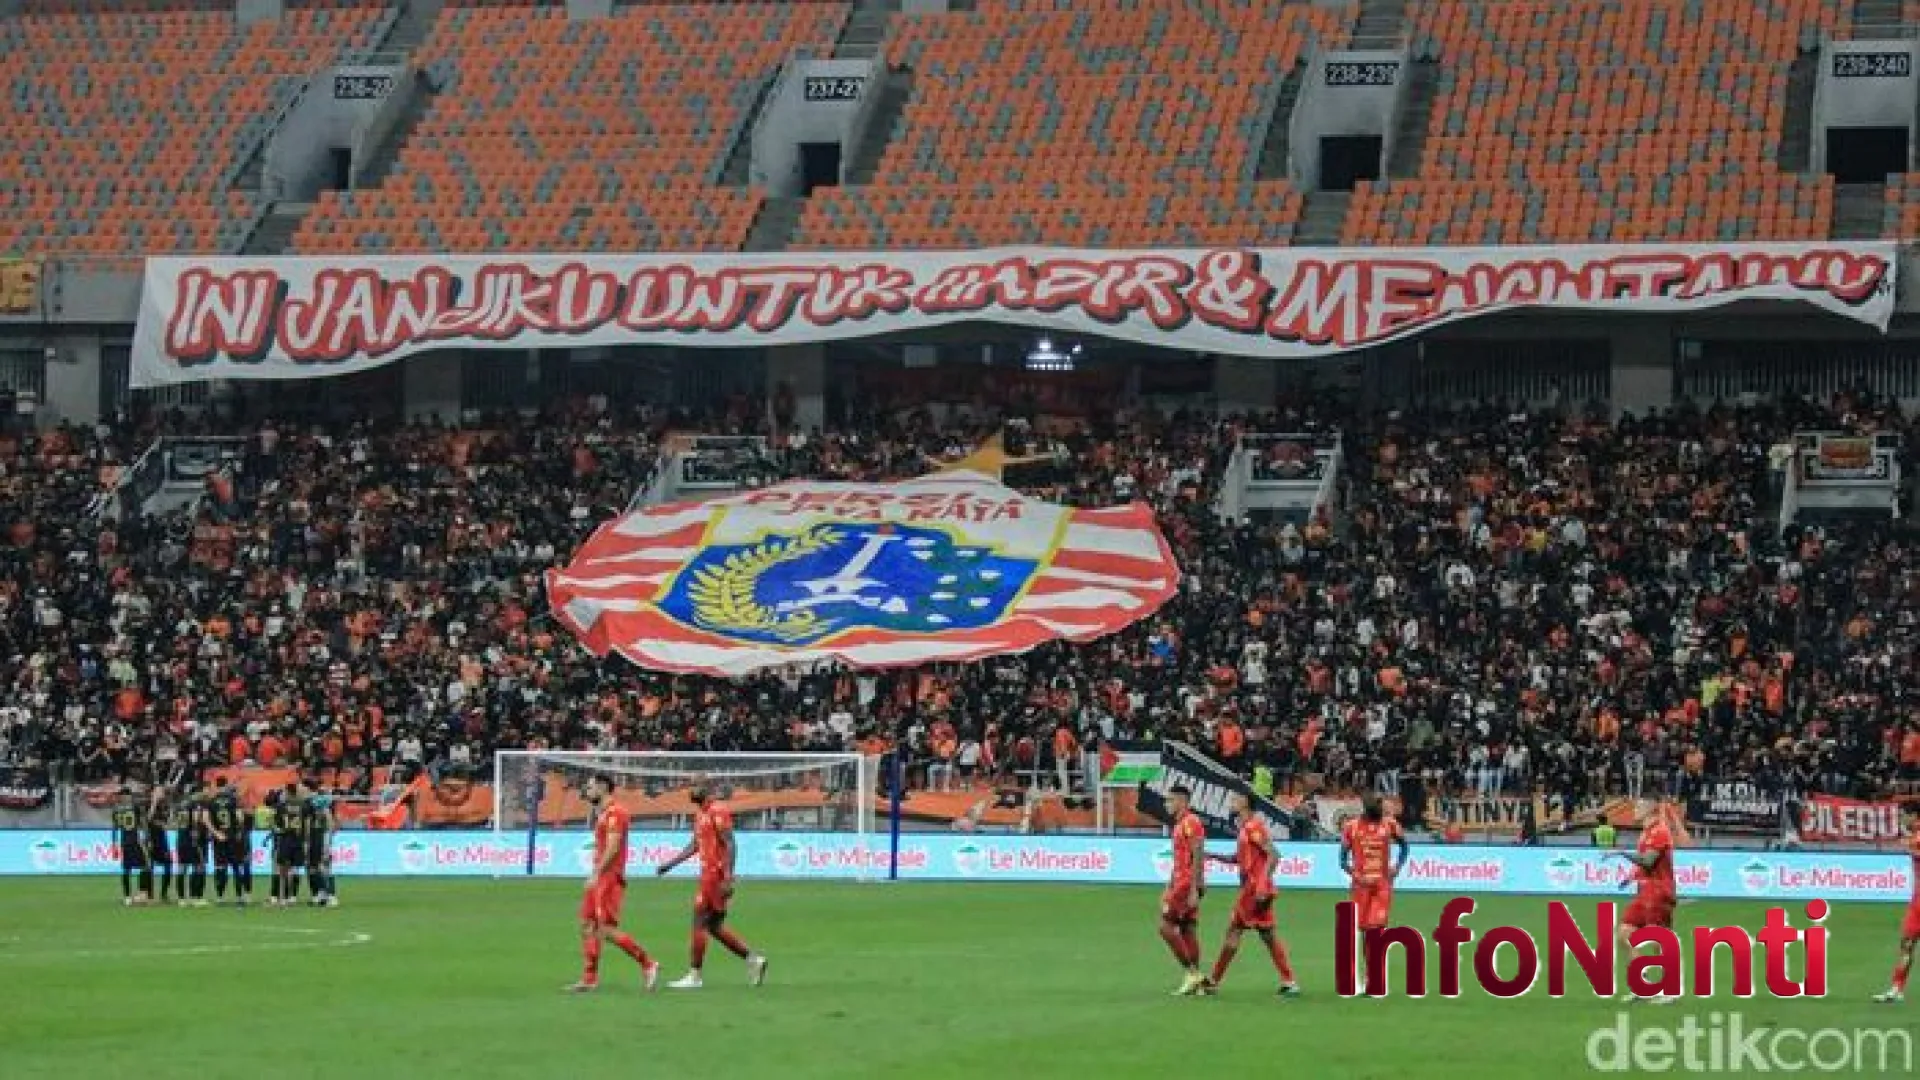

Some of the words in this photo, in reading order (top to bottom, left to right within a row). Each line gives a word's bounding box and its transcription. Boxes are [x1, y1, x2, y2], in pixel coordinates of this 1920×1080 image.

[1327, 64, 1398, 84] 238-239
[1836, 55, 1908, 76] 239-240
[165, 265, 292, 367] INI
[616, 263, 913, 333] UNTUK
[1184, 248, 1276, 334] &
[67, 844, 89, 863] Le
[435, 845, 457, 864] Le
[808, 846, 832, 867] Le
[989, 848, 1013, 870] Le
[1019, 848, 1109, 871] Minerale
[1408, 859, 1501, 879] Minerale
[1584, 862, 1609, 884] Le
[1779, 865, 1803, 886] Le
[1811, 867, 1907, 889] Minerale
